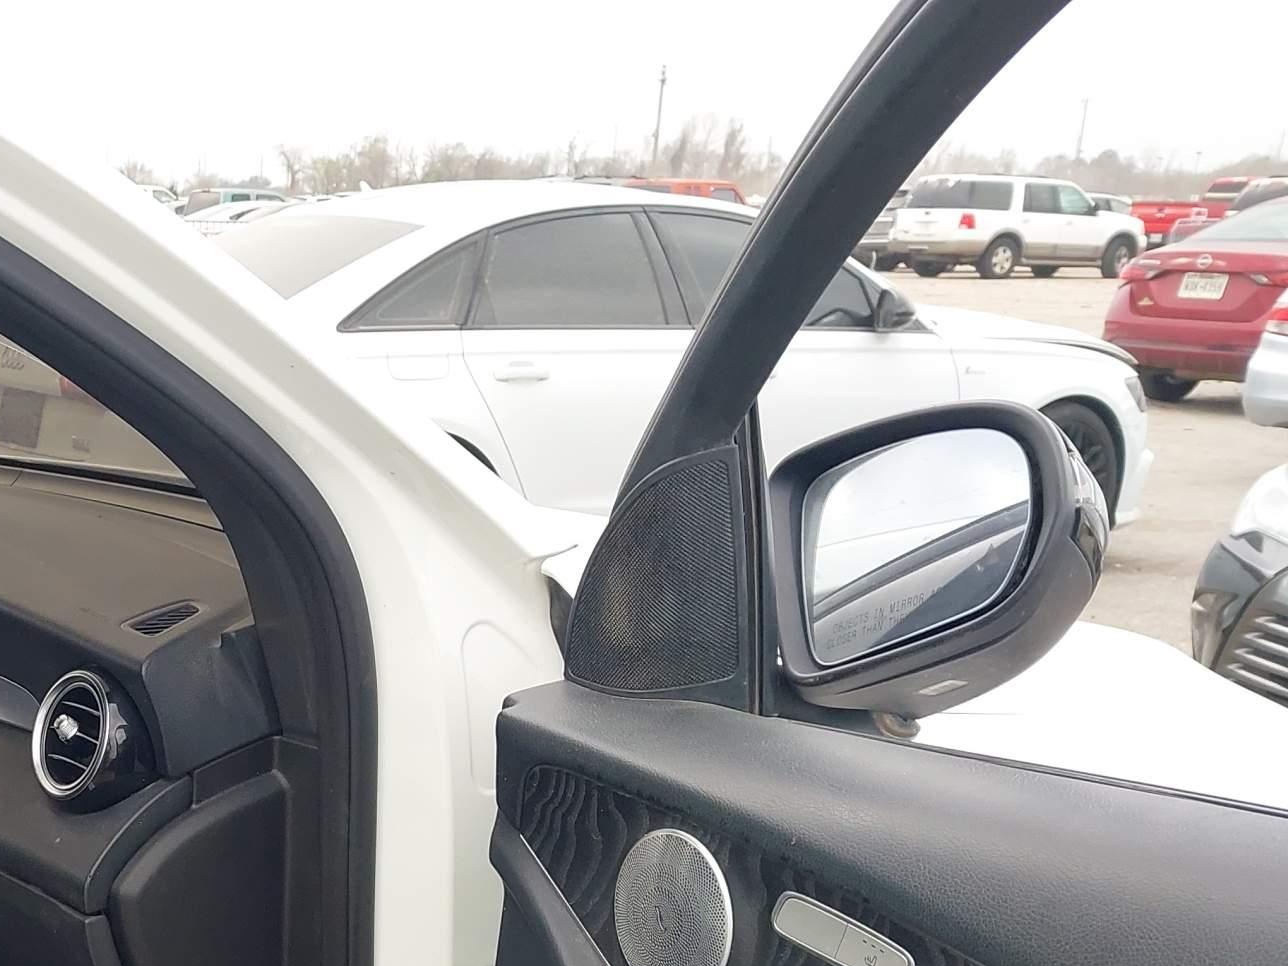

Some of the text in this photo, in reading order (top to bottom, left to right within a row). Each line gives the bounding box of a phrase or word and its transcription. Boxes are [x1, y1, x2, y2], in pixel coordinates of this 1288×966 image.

[874, 607, 884, 618] IN
[889, 592, 926, 613] MIRROR
[862, 621, 884, 637] THAN
